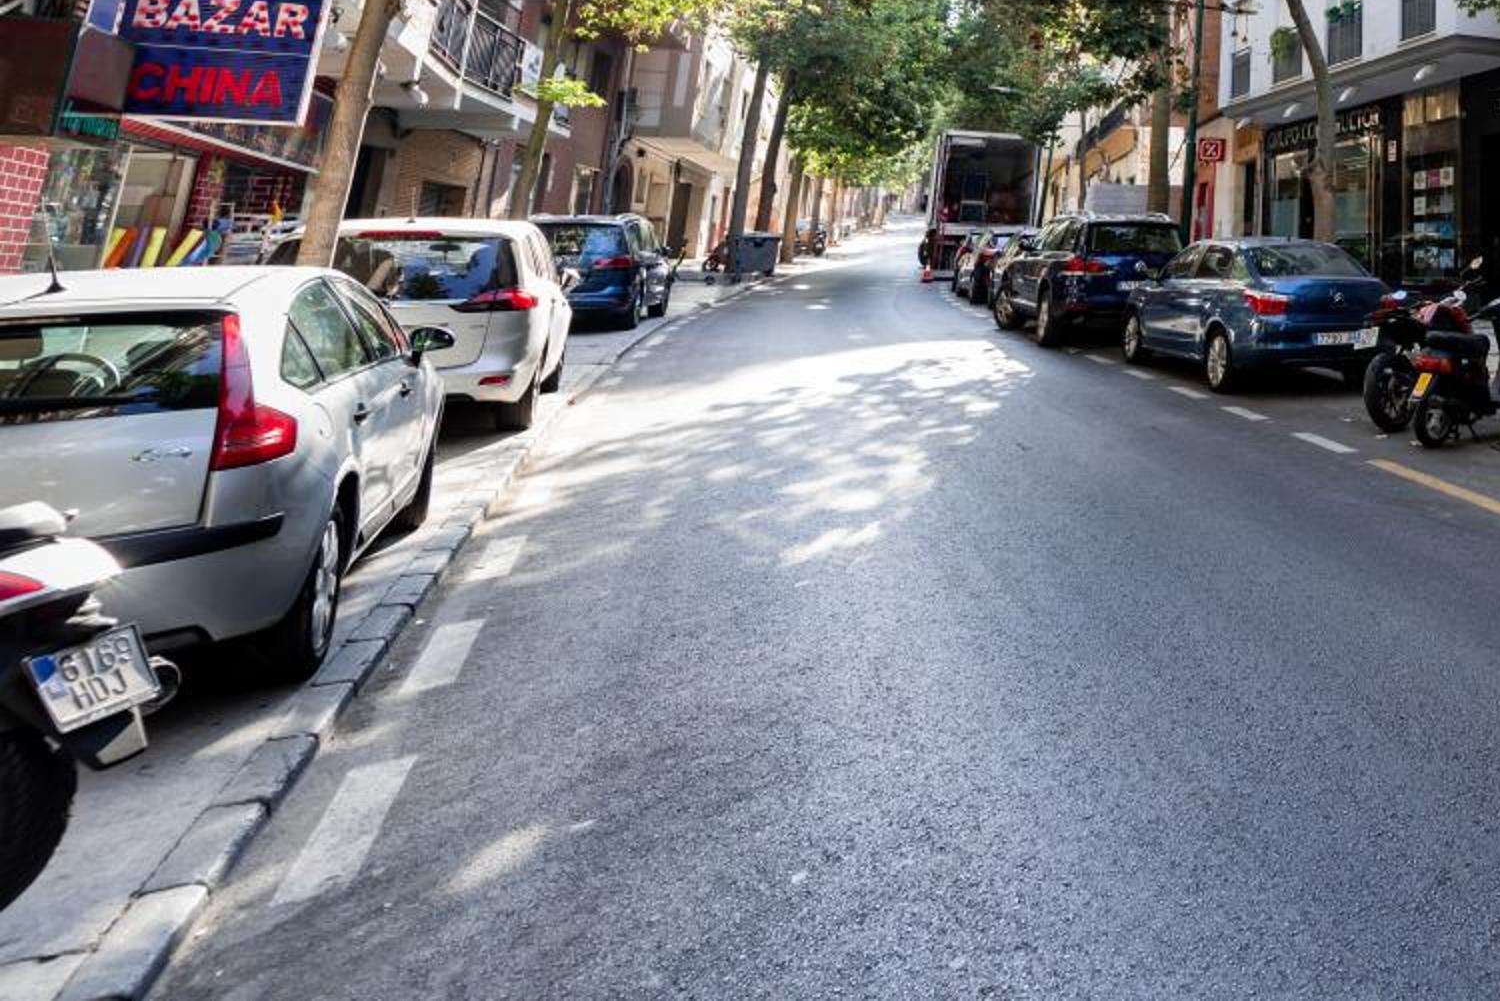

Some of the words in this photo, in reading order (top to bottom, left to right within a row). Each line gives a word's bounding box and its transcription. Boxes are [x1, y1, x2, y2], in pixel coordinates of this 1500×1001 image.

[128, 62, 283, 108] CHINA
[59, 635, 131, 682] 6169
[69, 667, 128, 709] HDJ
